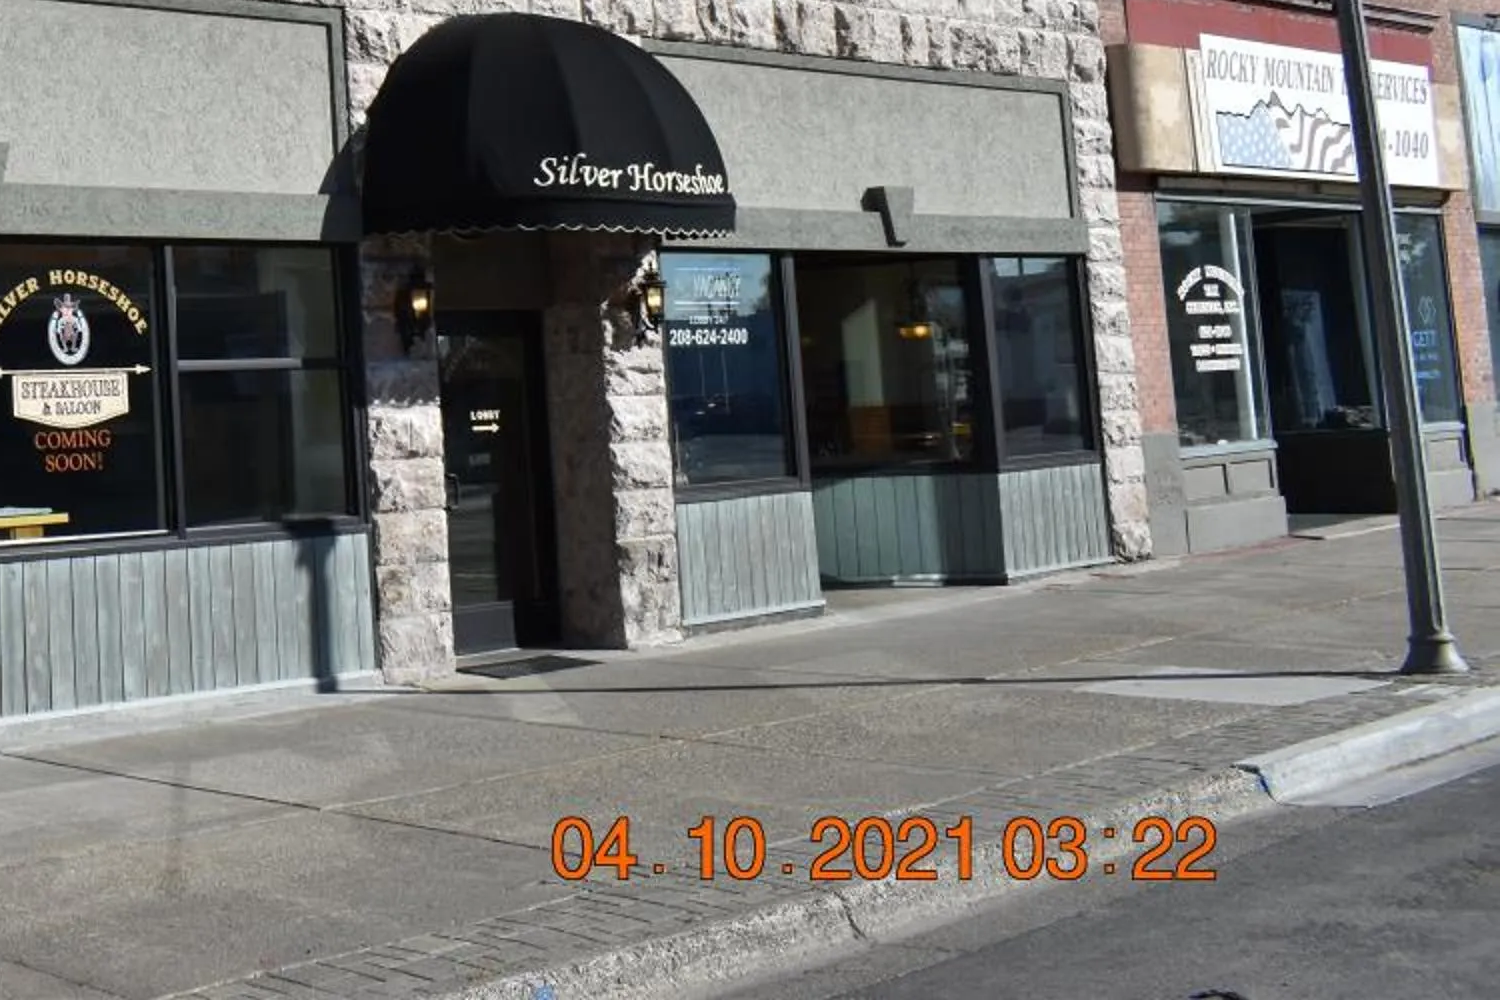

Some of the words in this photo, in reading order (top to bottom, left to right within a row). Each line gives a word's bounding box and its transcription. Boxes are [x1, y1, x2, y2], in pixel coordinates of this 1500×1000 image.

[1206, 49, 1258, 84] ROCKY
[1263, 57, 1335, 93] MOUNTAIN
[534, 153, 623, 189] Silver
[627, 163, 727, 195] Horseshoe
[48, 268, 149, 336] HORSESHOE
[669, 327, 749, 346] 208-624-2400
[20, 379, 121, 400] STEAKHOUSE
[55, 400, 102, 416] SALOON
[469, 409, 501, 421] LOBBY
[34, 429, 112, 450] COMING
[44, 452, 104, 473] SOON!
